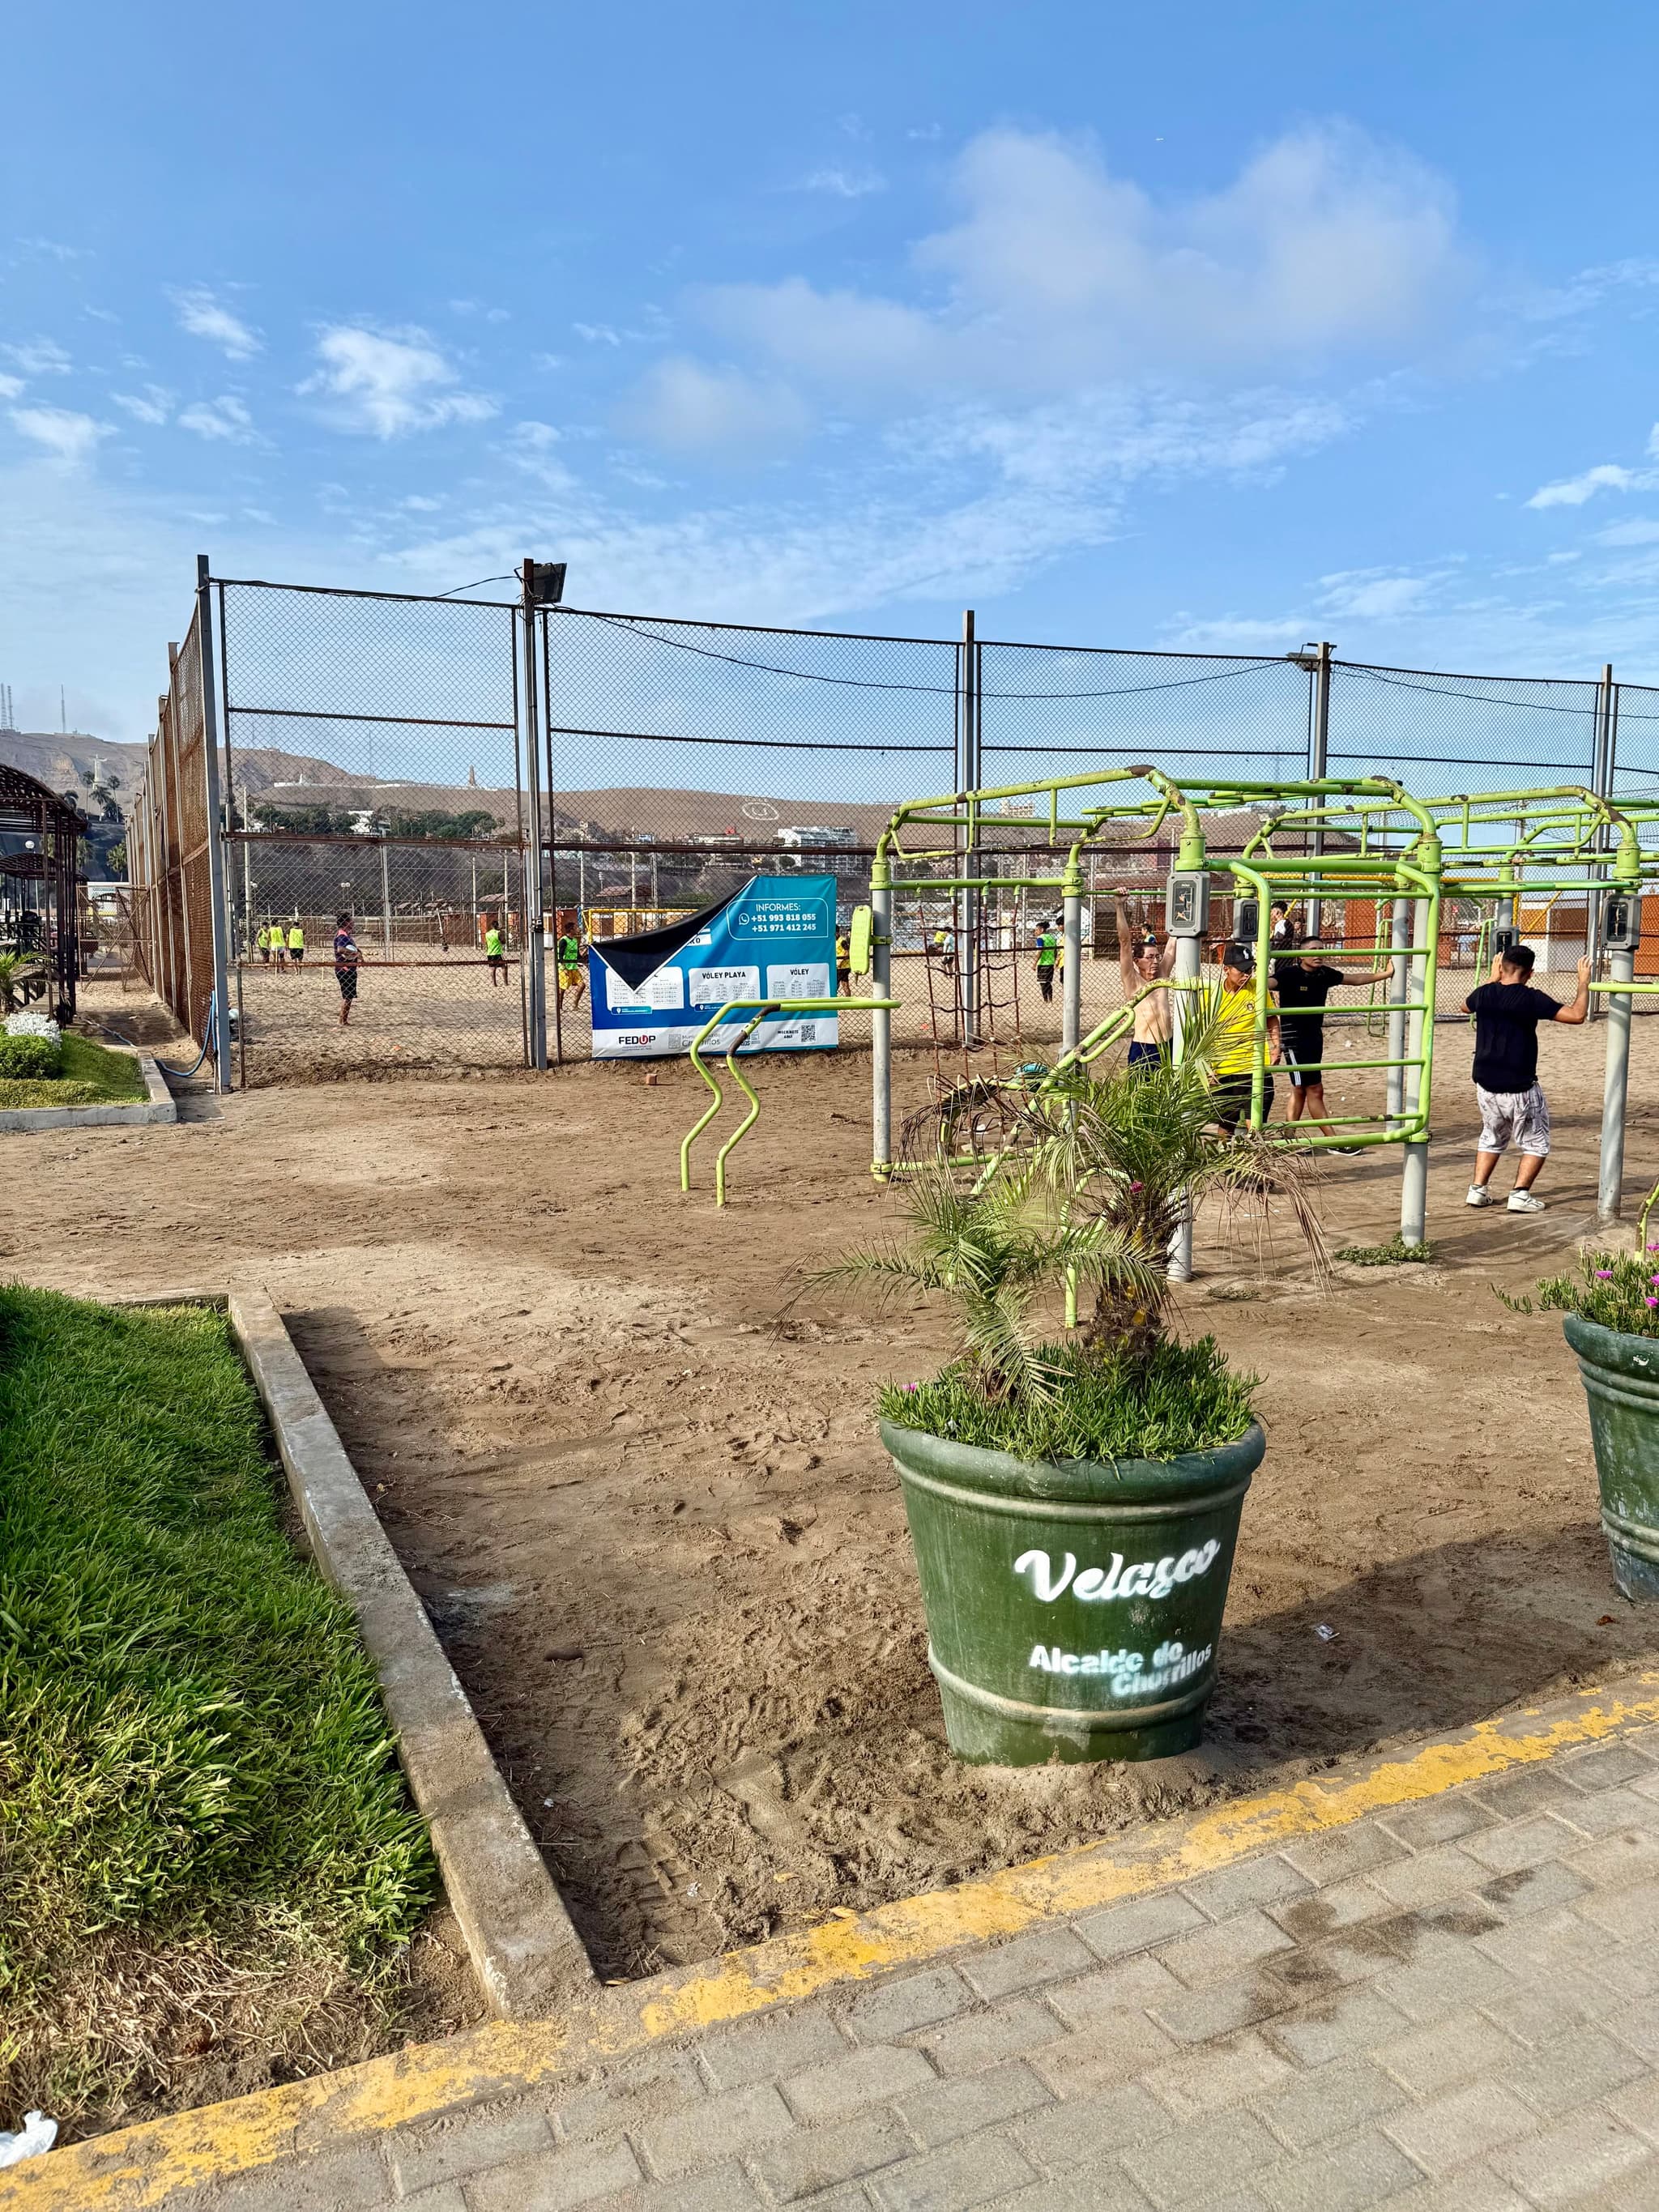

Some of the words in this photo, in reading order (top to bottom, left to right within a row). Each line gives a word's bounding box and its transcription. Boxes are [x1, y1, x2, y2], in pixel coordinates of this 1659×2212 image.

[756, 903, 801, 912] INFORMES:
[702, 971, 723, 979] VÓLEY
[790, 968, 809, 976] VÓLEY
[1014, 1538, 1222, 1602] Velasco
[1029, 1644, 1145, 1674] Alcalde
[1153, 1640, 1184, 1669] de
